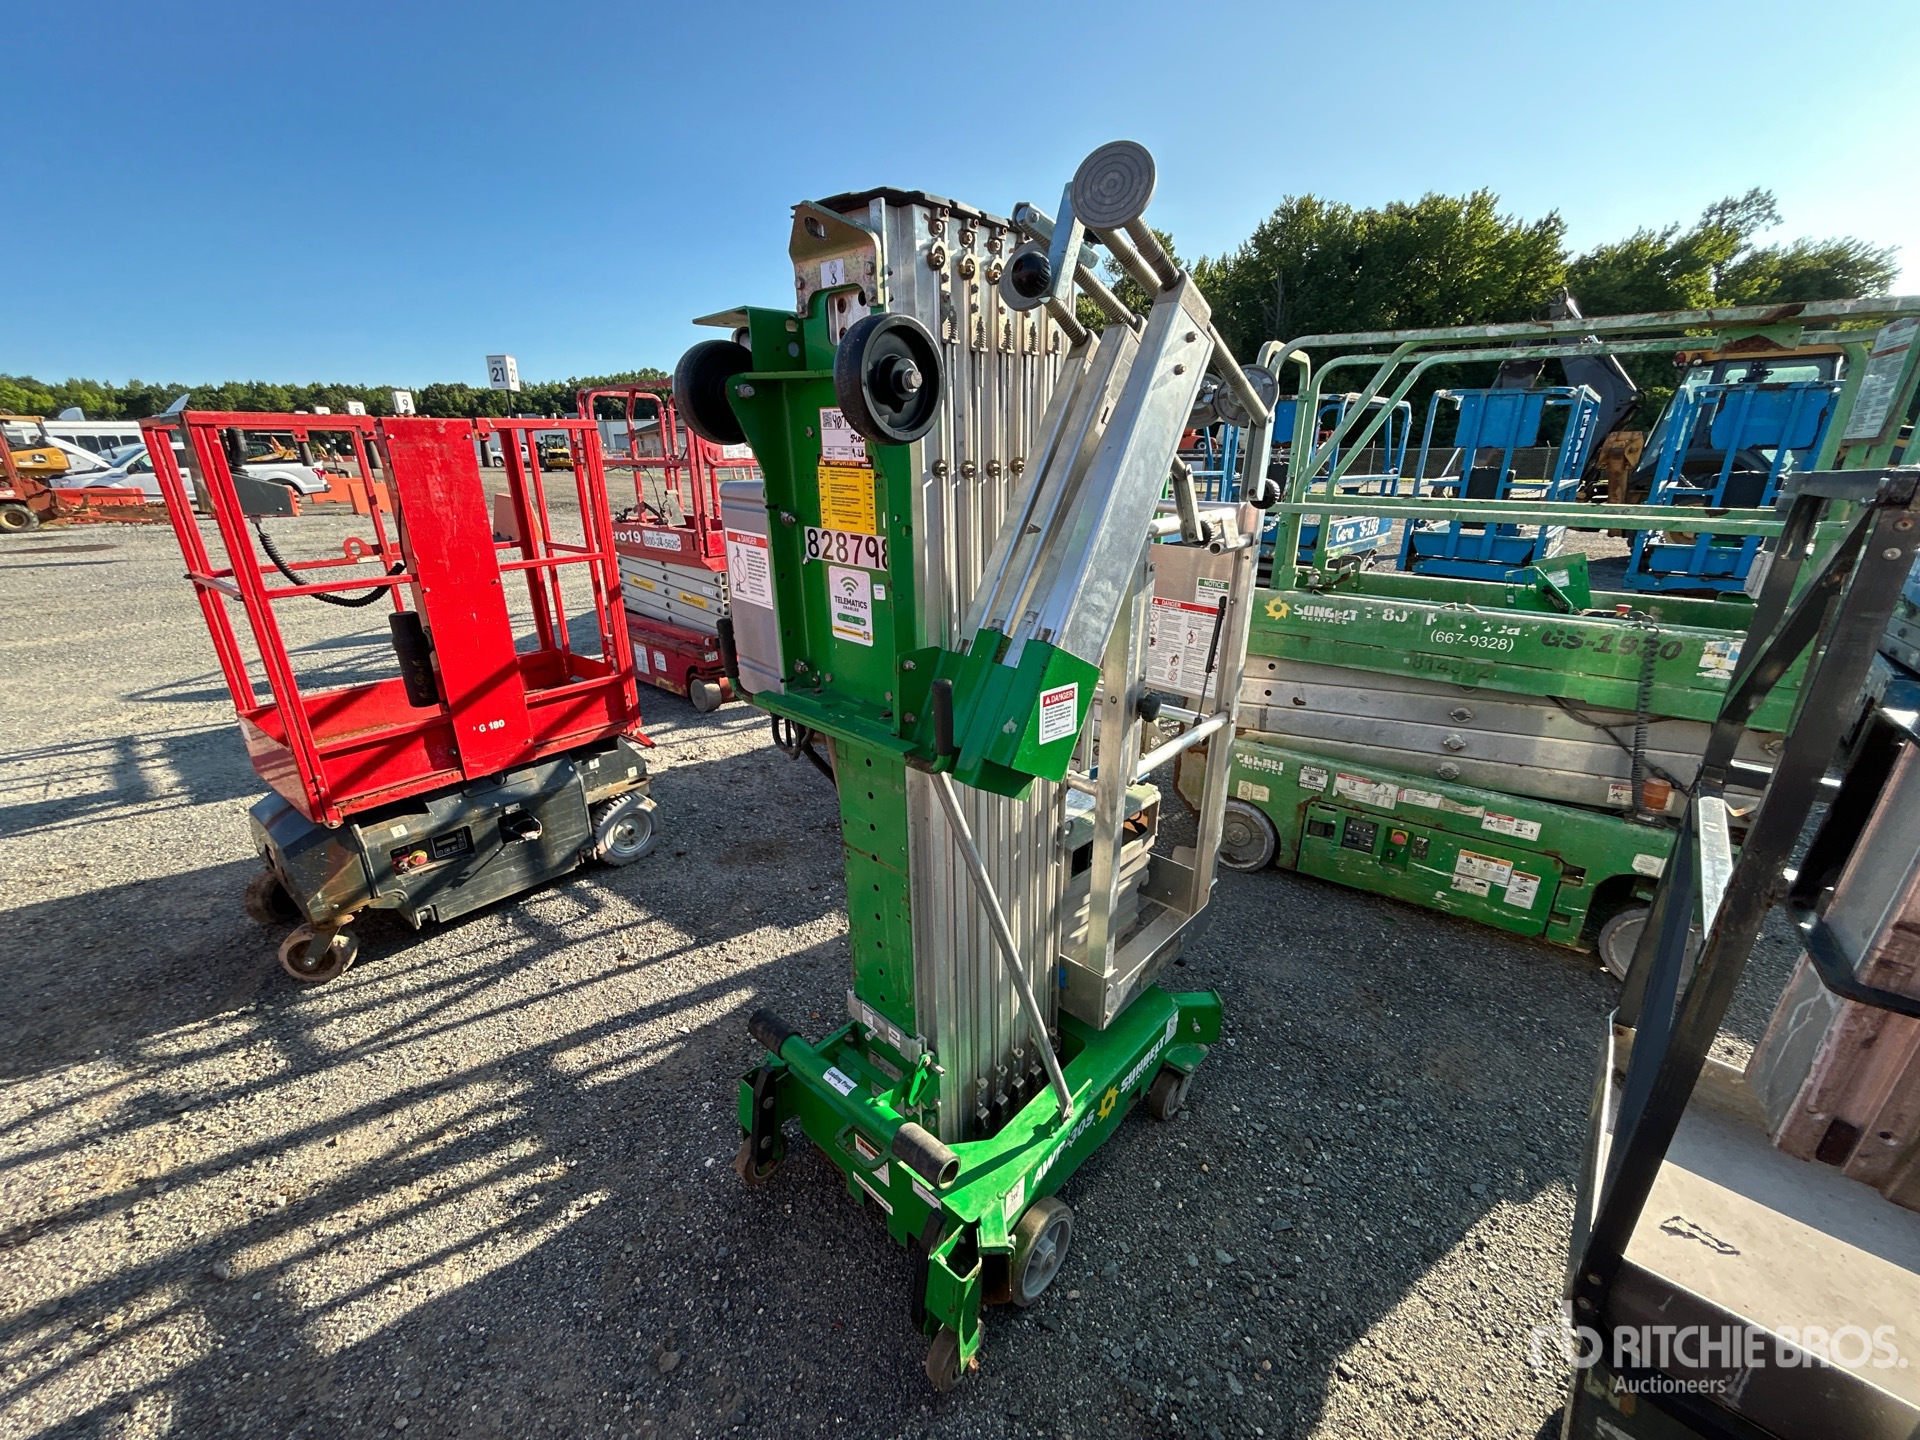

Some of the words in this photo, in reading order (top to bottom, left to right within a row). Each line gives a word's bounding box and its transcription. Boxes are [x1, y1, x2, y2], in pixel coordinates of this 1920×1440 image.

[491, 367, 506, 382] 21
[402, 399, 409, 408] 9
[1203, 580, 1225, 589] NOTICE
[834, 595, 868, 610] TELEMATICS
[1161, 599, 1182, 608] DANGER
[1050, 689, 1074, 703] DANGER
[488, 719, 506, 731] 180
[1303, 765, 1327, 775] ALWAYS
[1120, 1034, 1166, 1094] SUNBELT
